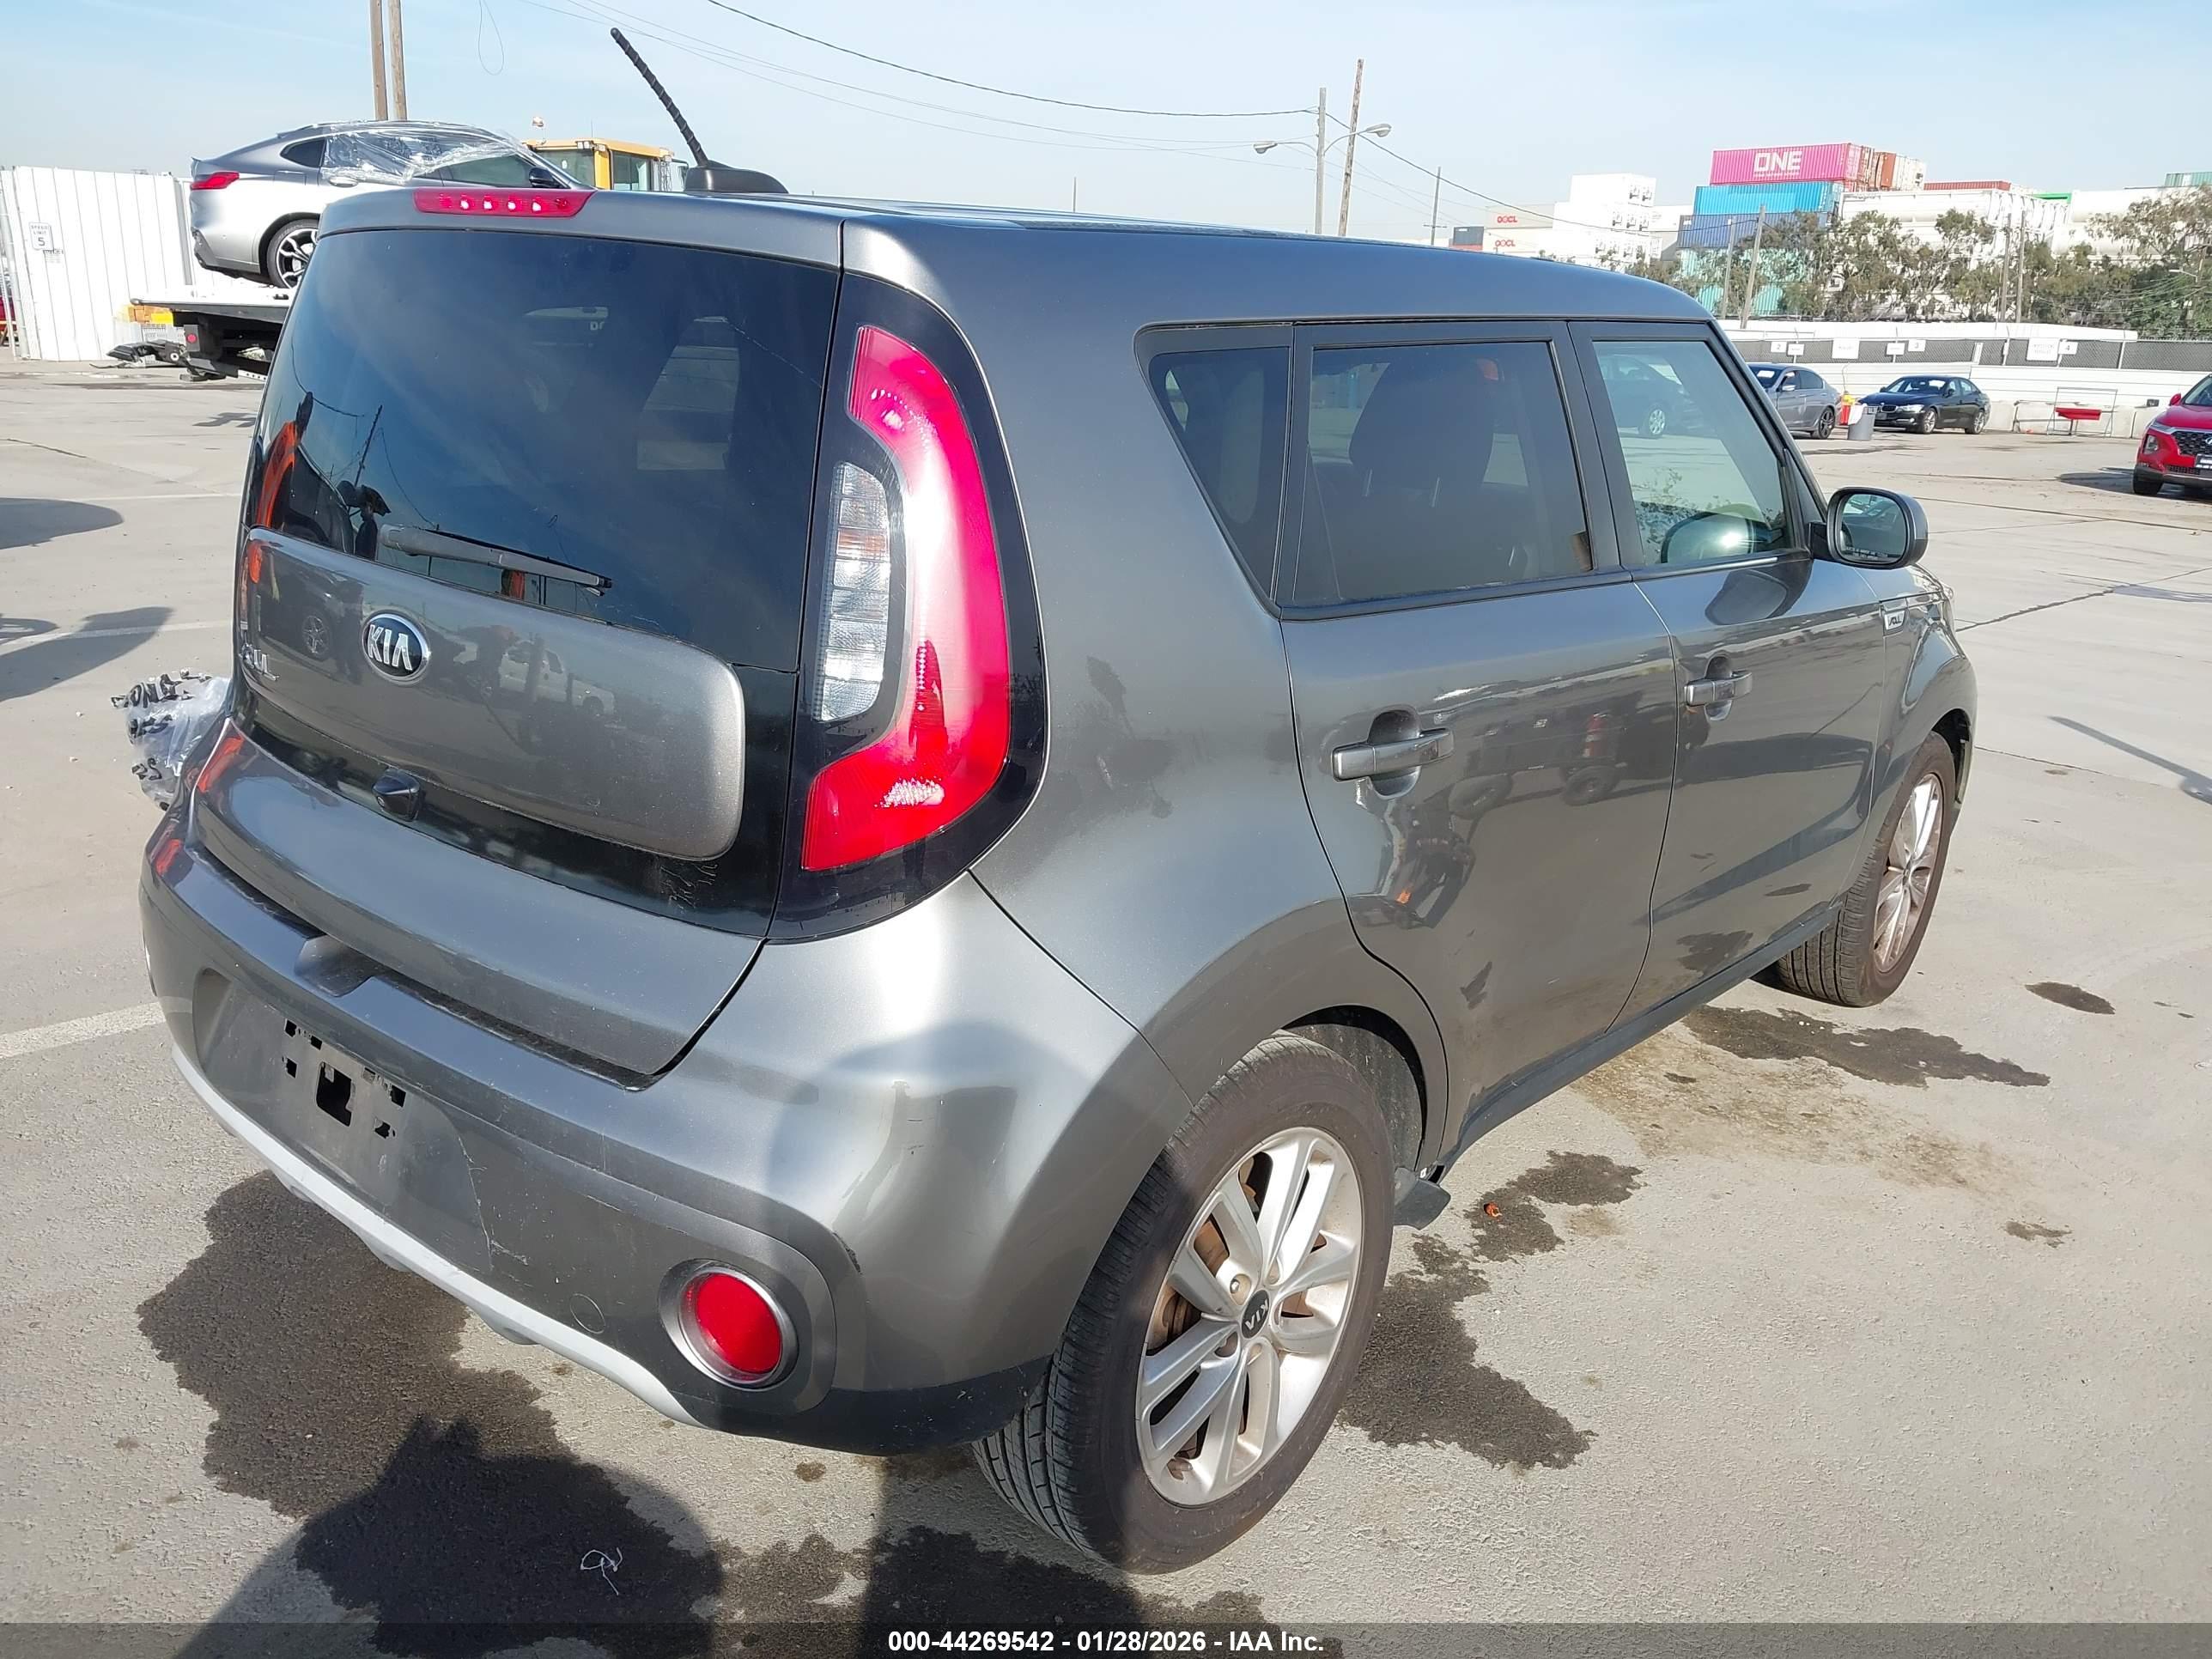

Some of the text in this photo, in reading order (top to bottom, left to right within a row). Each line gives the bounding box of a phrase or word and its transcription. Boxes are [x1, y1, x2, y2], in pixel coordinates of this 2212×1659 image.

[1753, 150, 1802, 172] ONE
[38, 237, 46, 246] 5
[368, 624, 412, 671] KIA
[1245, 1298, 1268, 1330] KIA
